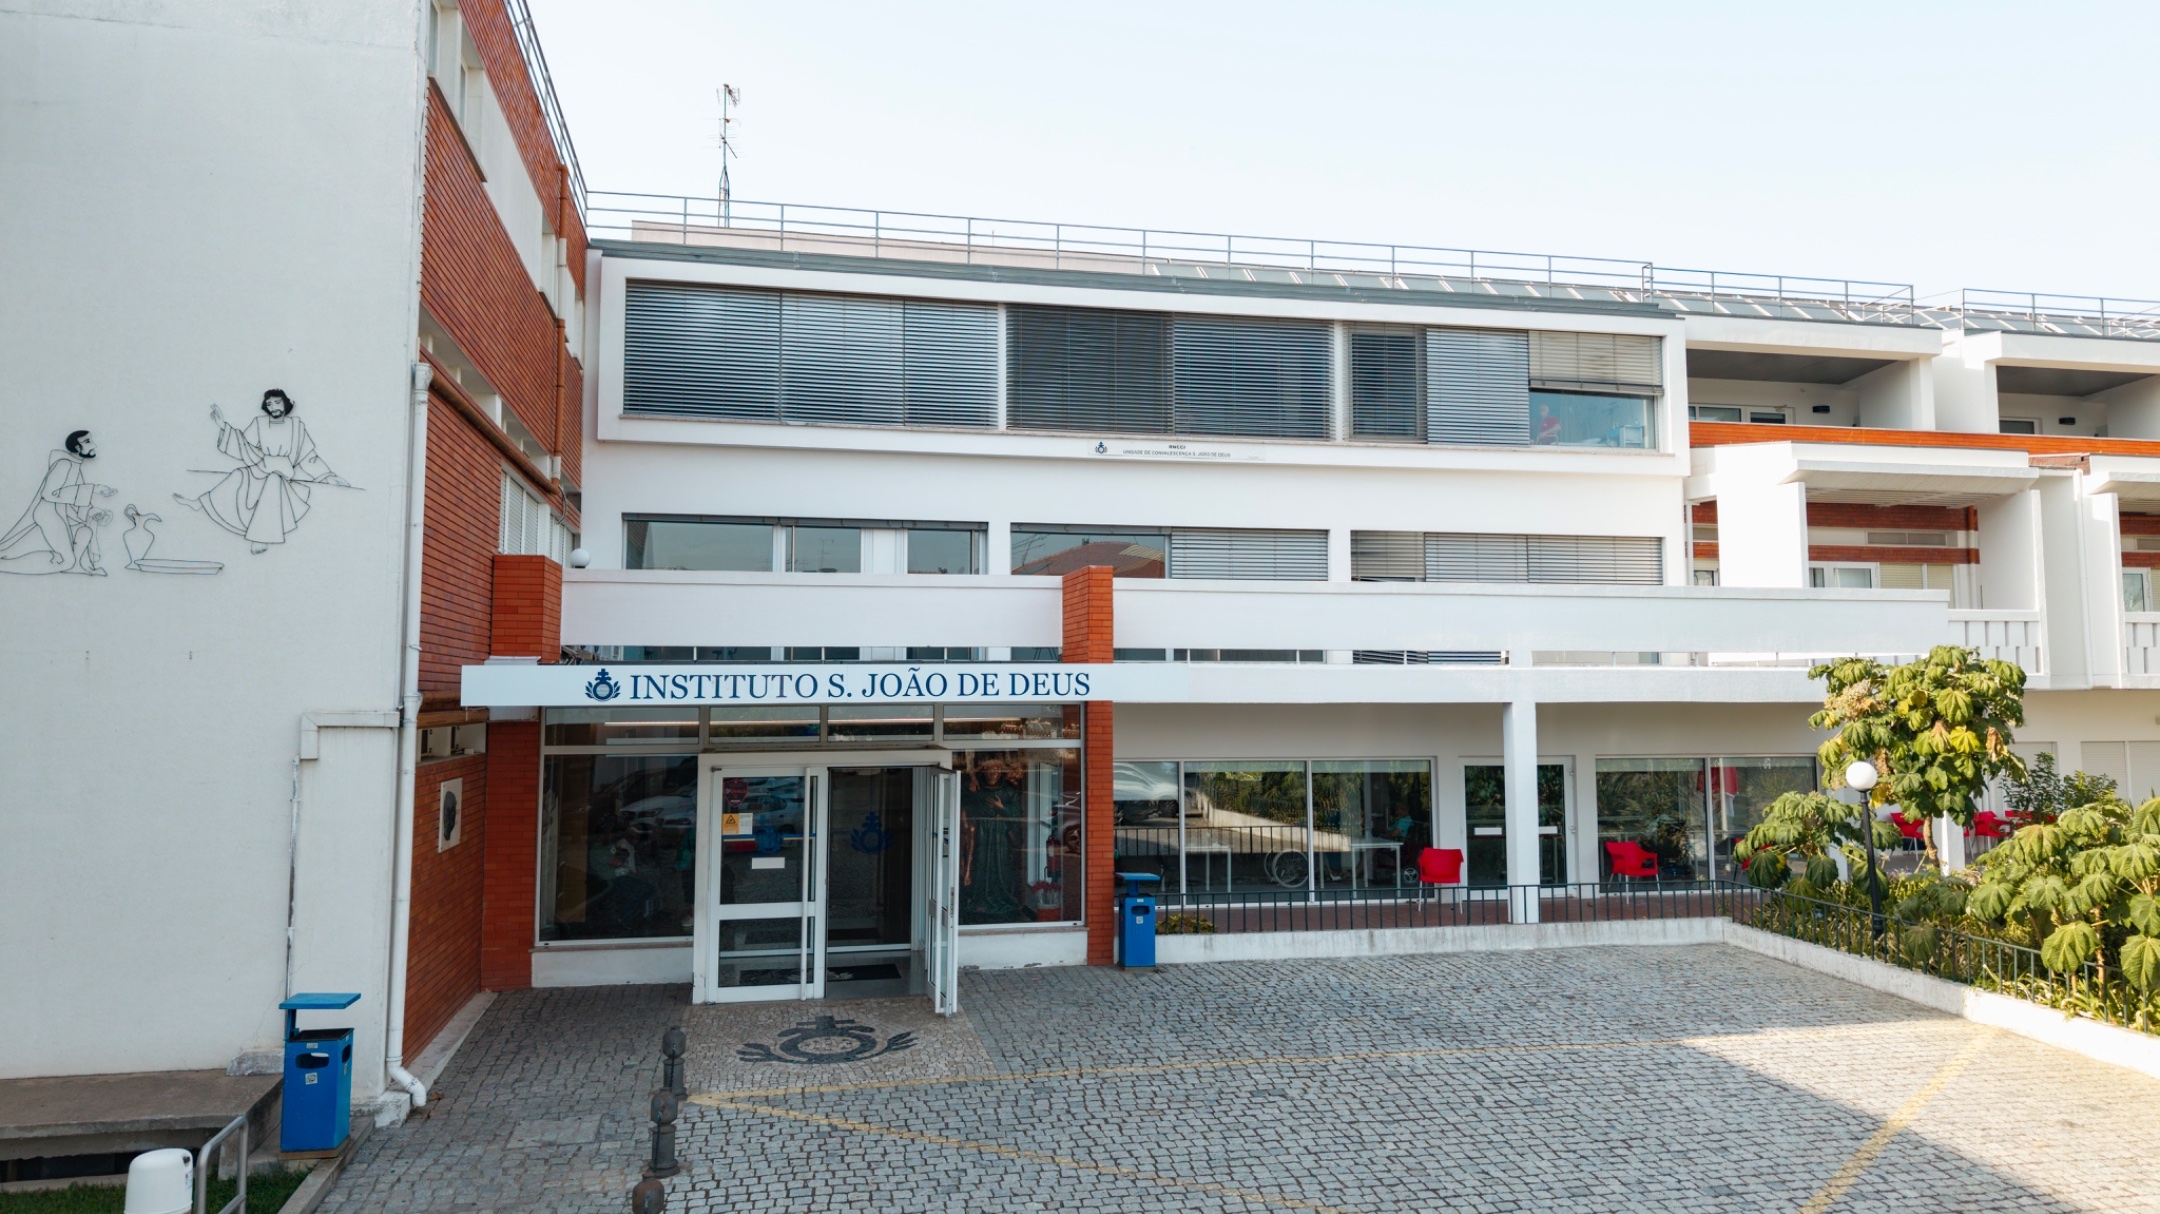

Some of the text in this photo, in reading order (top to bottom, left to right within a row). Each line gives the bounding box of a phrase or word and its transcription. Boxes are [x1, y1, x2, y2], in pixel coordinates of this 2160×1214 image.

[629, 667, 1090, 700] INSTITUTO S. JOÃO DE DEUS
